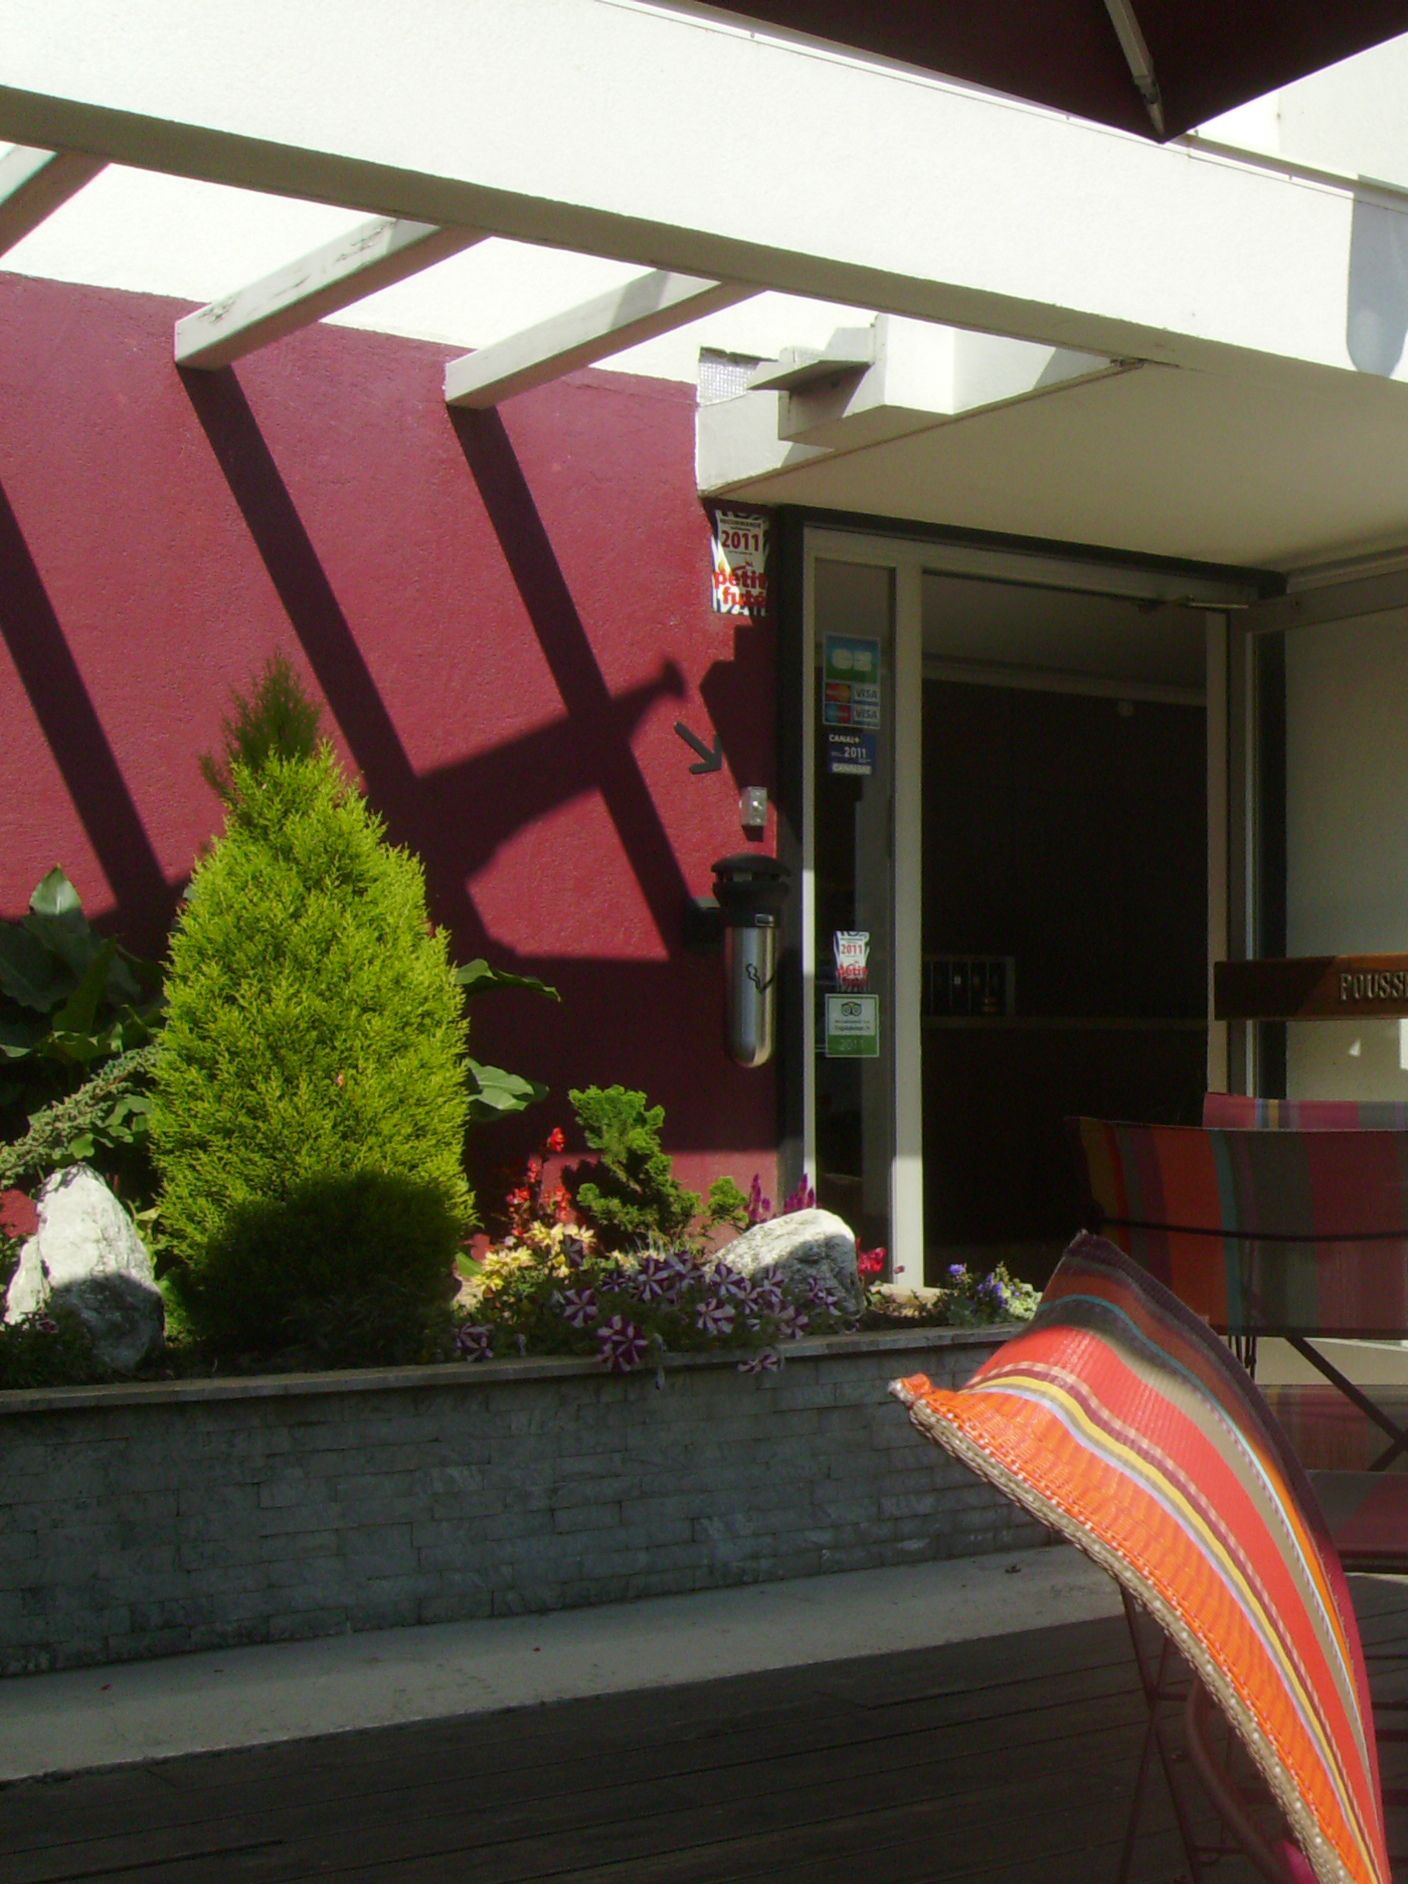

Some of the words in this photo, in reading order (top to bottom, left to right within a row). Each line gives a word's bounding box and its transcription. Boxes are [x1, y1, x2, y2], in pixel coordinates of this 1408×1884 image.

[721, 529, 759, 552] 2011
[714, 569, 766, 590] petit
[855, 688, 878, 699] VISA
[855, 707, 878, 719] VISA
[844, 747, 867, 758] 2011
[841, 943, 862, 955] 2011
